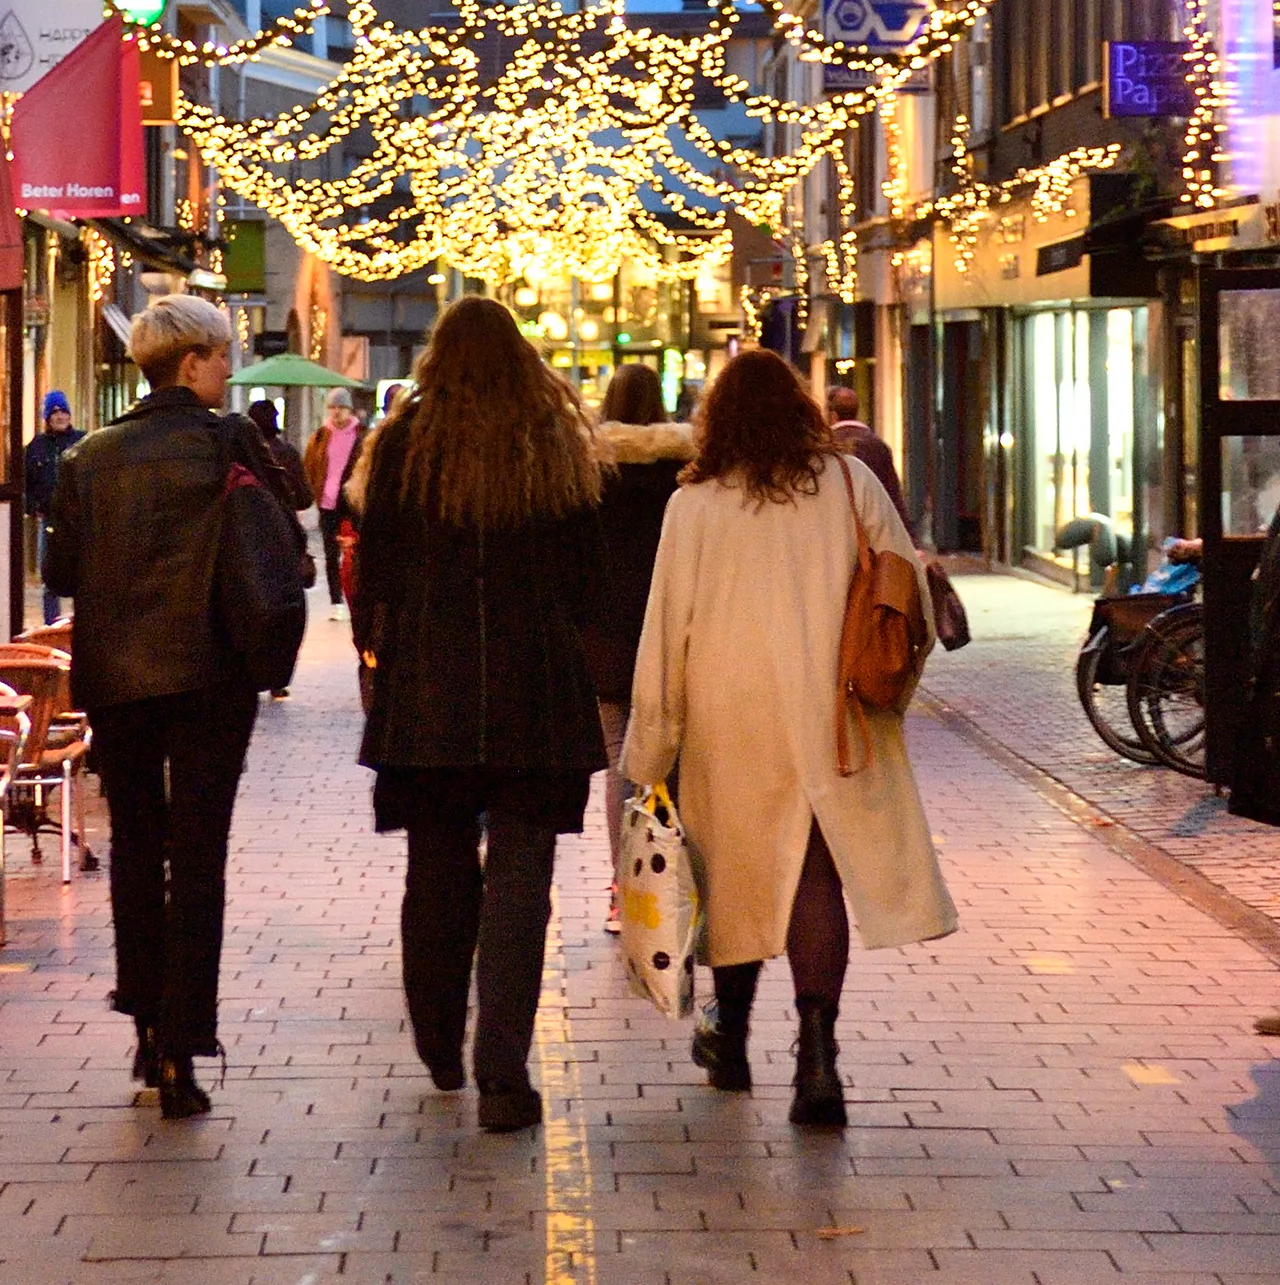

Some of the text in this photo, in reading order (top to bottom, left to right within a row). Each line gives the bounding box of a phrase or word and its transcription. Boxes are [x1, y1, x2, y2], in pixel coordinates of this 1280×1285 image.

[1114, 44, 1192, 77] Pizz
[20, 182, 114, 198] Beter Horen
